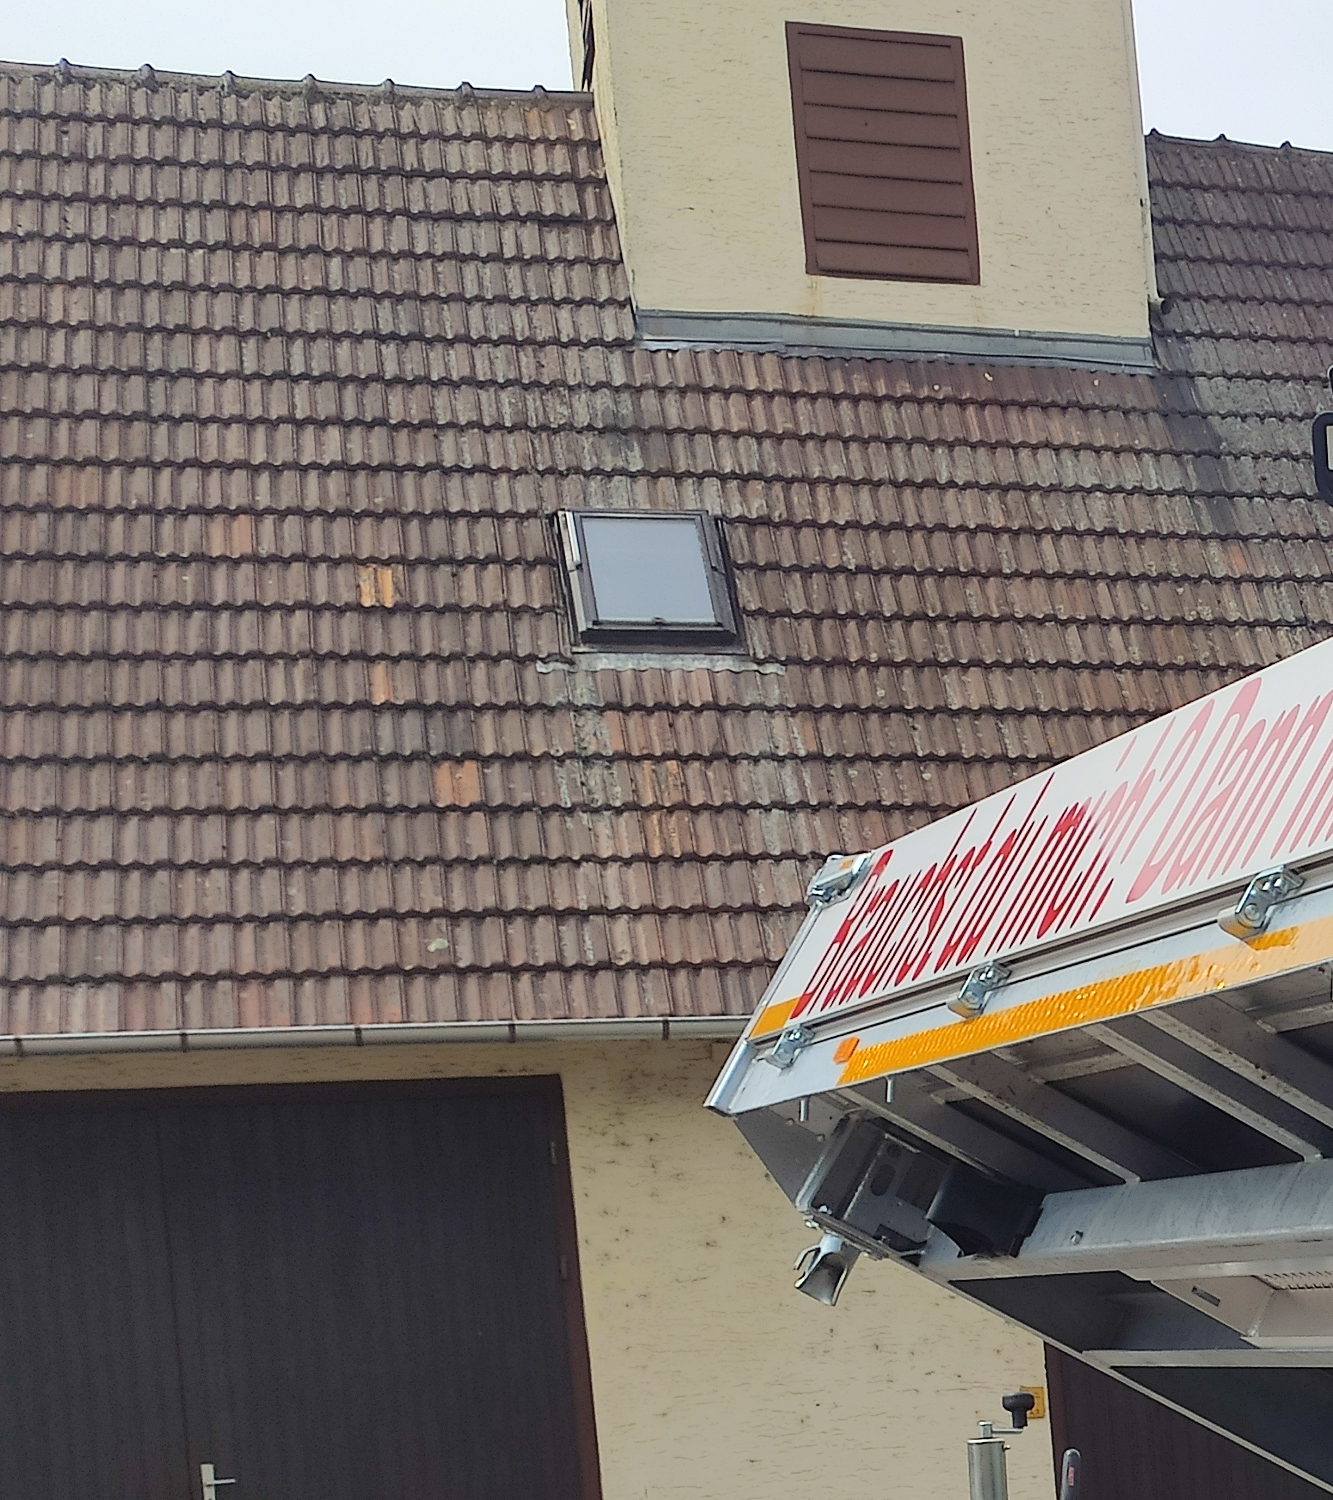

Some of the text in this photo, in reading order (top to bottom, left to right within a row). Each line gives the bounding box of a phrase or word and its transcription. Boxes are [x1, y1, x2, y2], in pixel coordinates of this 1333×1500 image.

[787, 795, 1017, 1020] Brauchst
[933, 772, 1055, 974] du
[985, 699, 1215, 956] mich?
